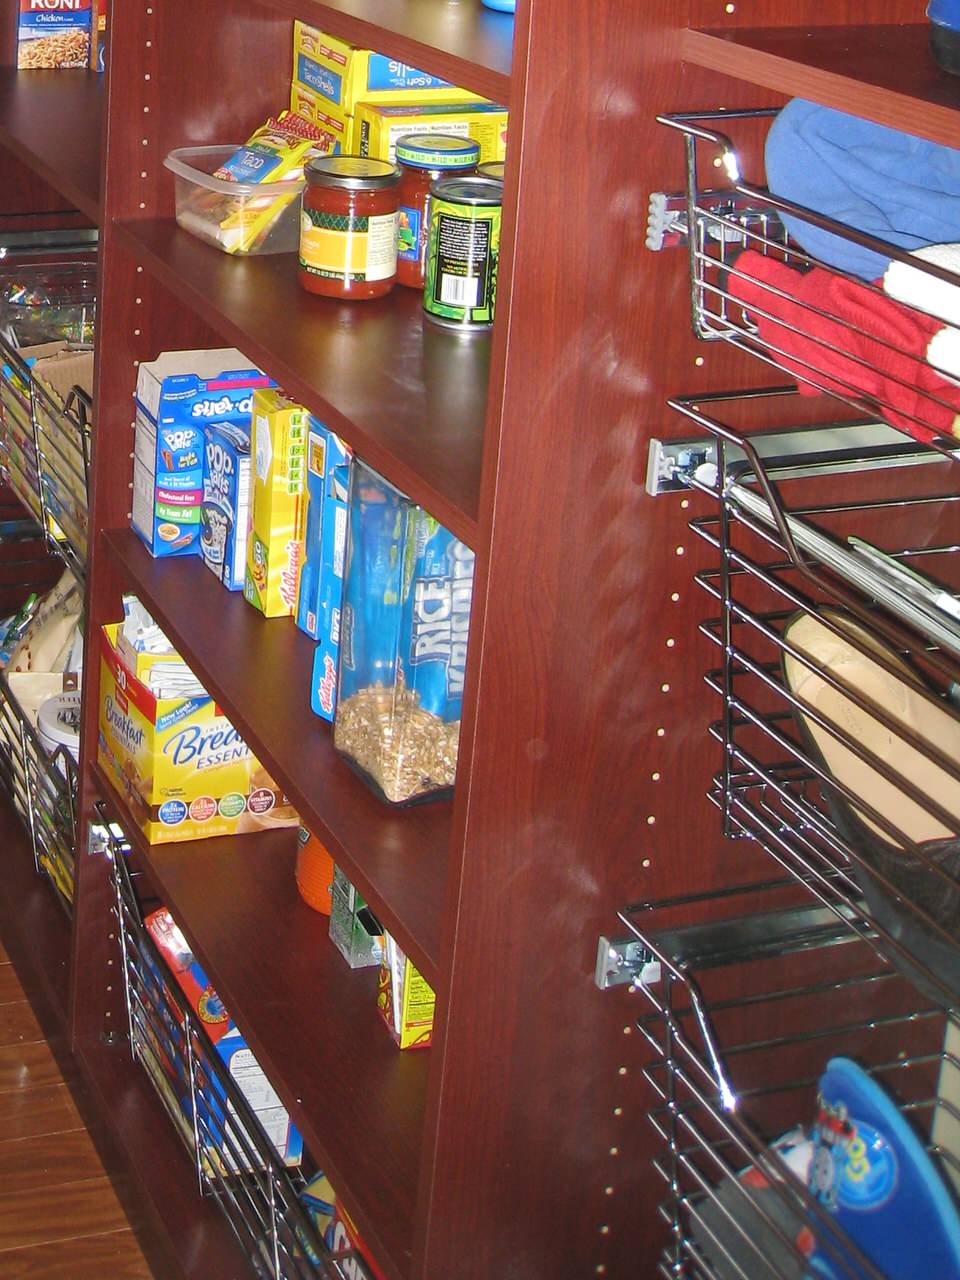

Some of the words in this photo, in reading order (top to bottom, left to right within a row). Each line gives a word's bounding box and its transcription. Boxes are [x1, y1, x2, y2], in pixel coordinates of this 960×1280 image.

[241, 150, 265, 170] Taco
[279, 539, 301, 608] Kellogg's
[414, 581, 452, 658] RICE
[318, 654, 338, 714] Kellogg's
[105, 695, 146, 746] Breakfast
[162, 725, 246, 766] Brea
